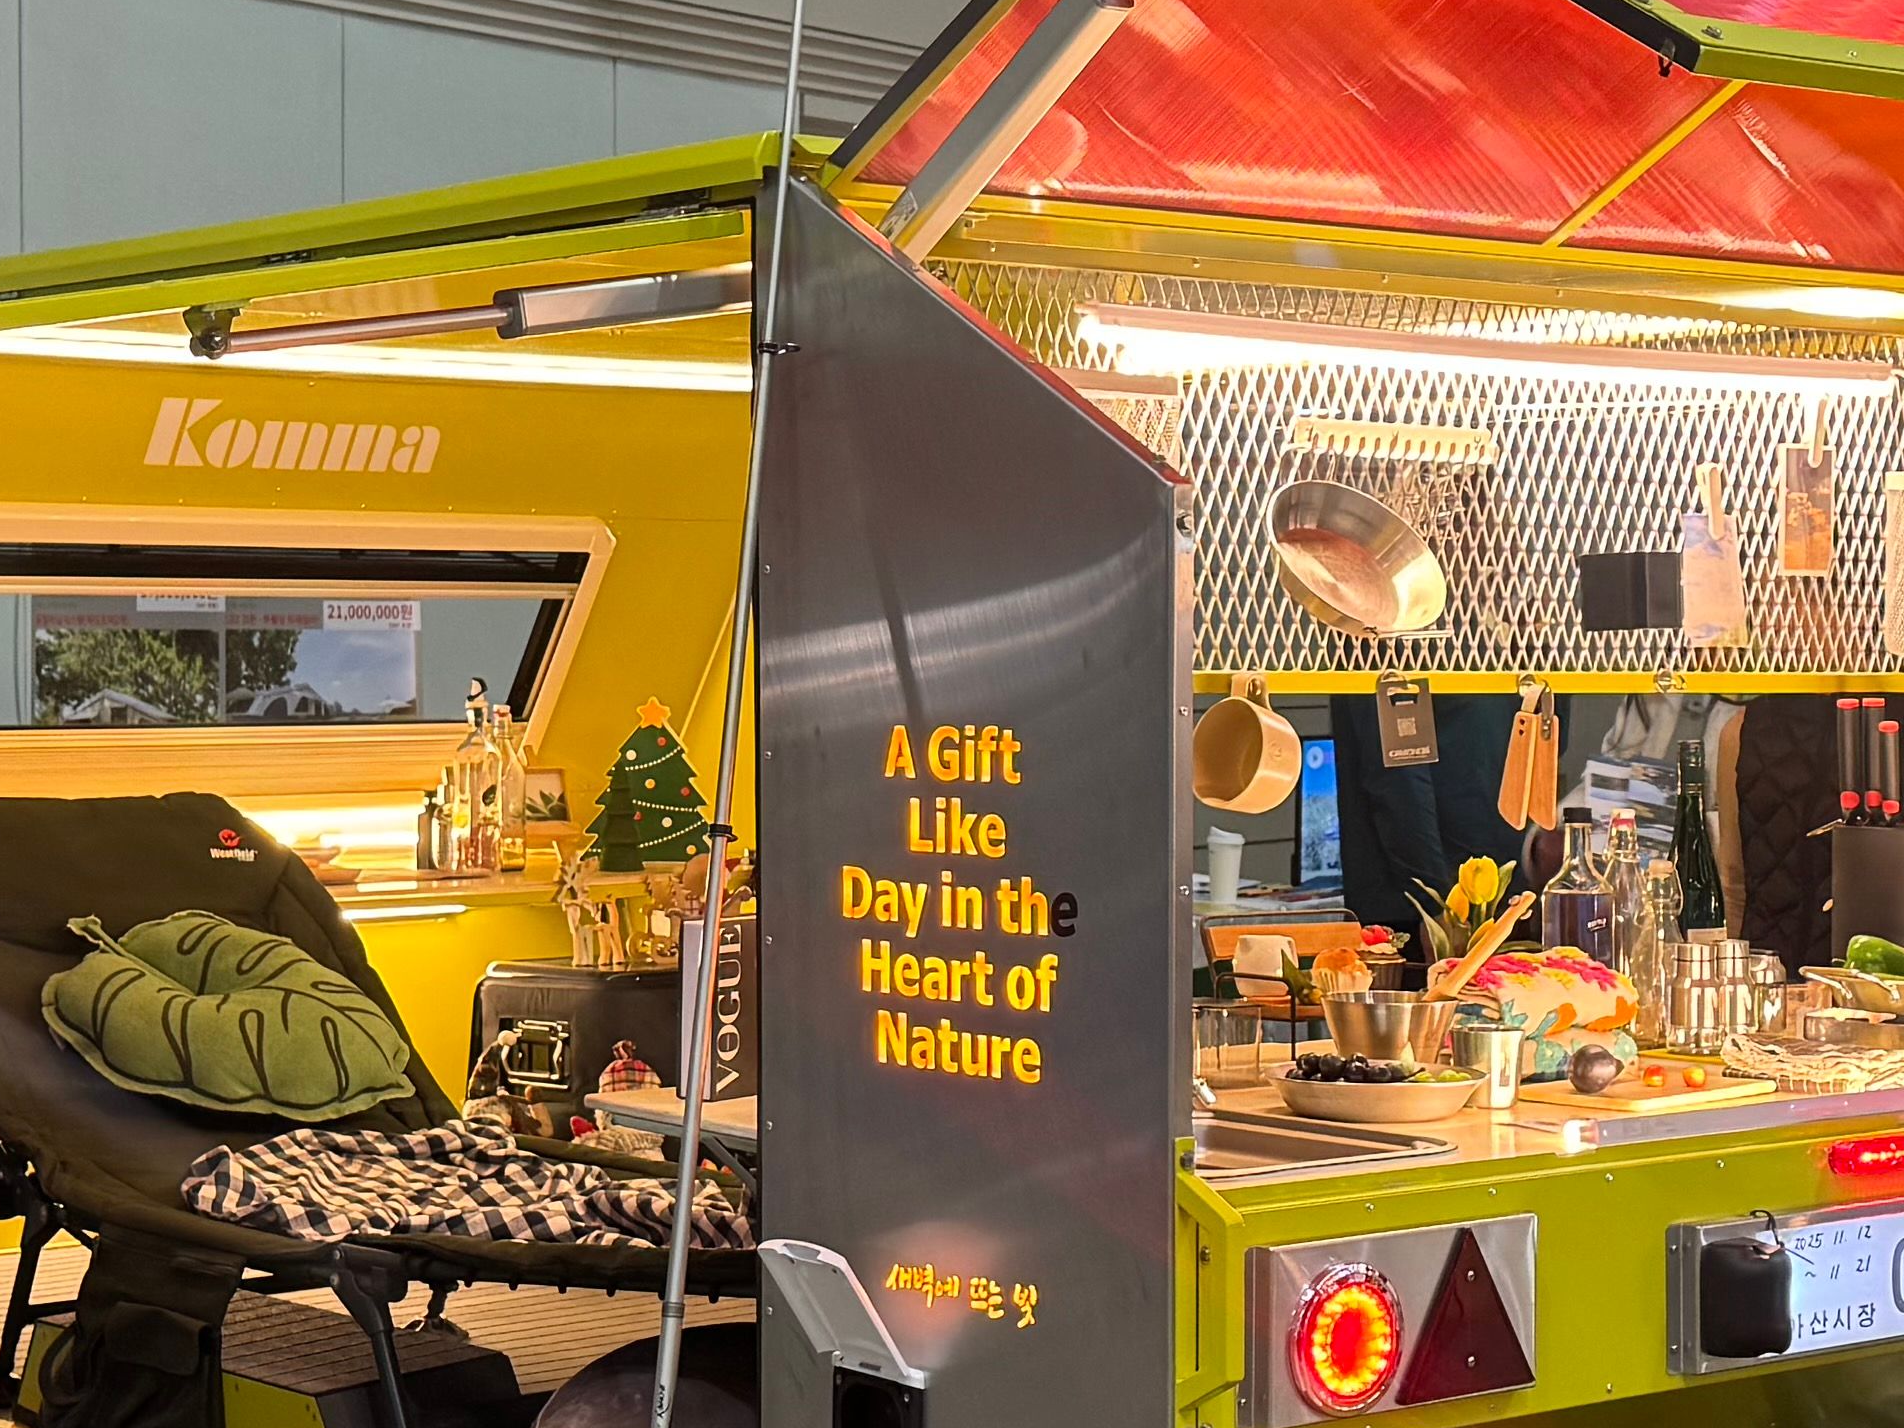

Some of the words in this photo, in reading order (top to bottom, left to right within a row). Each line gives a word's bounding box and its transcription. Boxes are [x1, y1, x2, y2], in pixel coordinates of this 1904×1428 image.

[143, 397, 442, 473] Komma
[327, 604, 413, 622] 21,000,000원
[884, 724, 916, 779] A
[927, 724, 1022, 784] Gift
[908, 796, 1007, 858] Like
[842, 865, 928, 938] Day
[940, 870, 984, 931] in
[996, 875, 1079, 938] the
[715, 924, 742, 1093] VOGUE
[861, 938, 995, 1007] Heart
[1006, 953, 1059, 1013] of
[875, 1009, 1043, 1084] Nature
[1858, 1225, 1872, 1241] 12
[885, 1262, 961, 1309] 새벽에
[969, 1276, 1005, 1320] 뜨는
